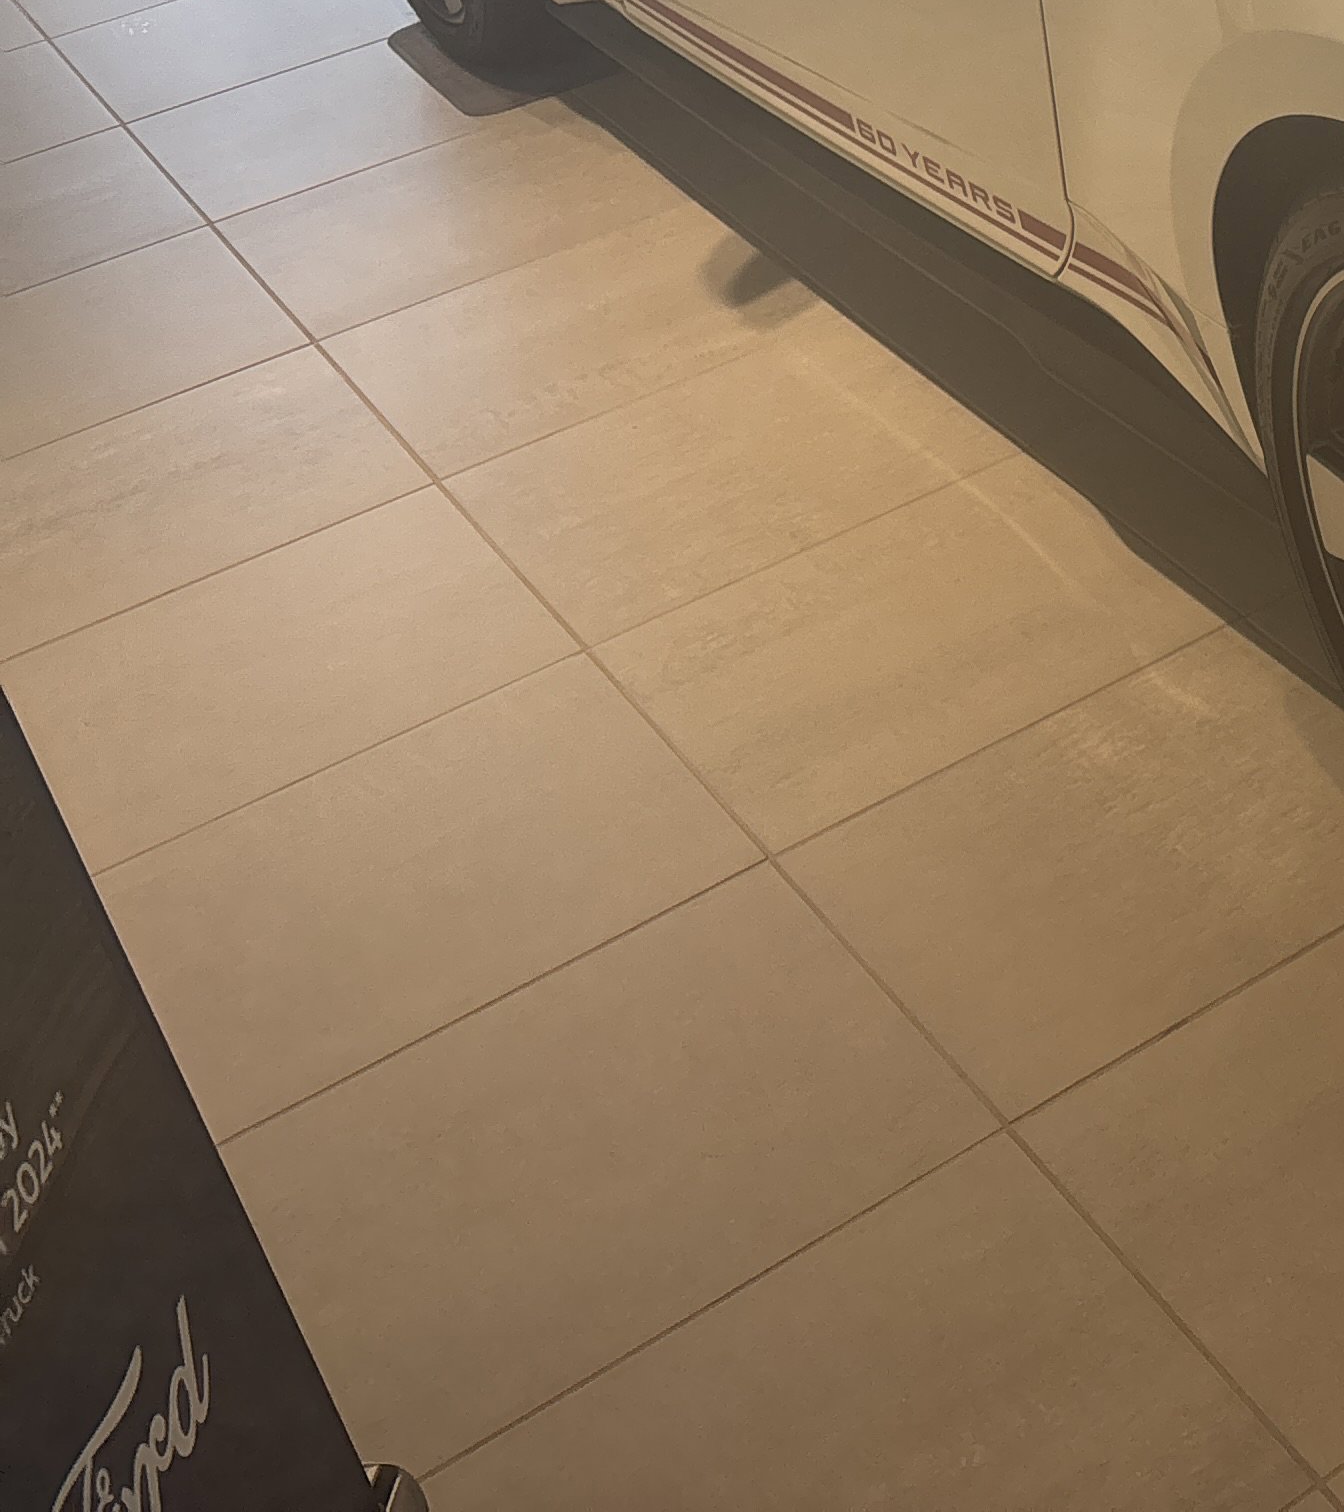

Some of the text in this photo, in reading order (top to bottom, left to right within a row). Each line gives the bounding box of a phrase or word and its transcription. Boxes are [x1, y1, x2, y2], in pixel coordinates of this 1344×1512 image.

[856, 118, 1016, 224] 60 YEARS
[0, 1264, 41, 1345] ruck
